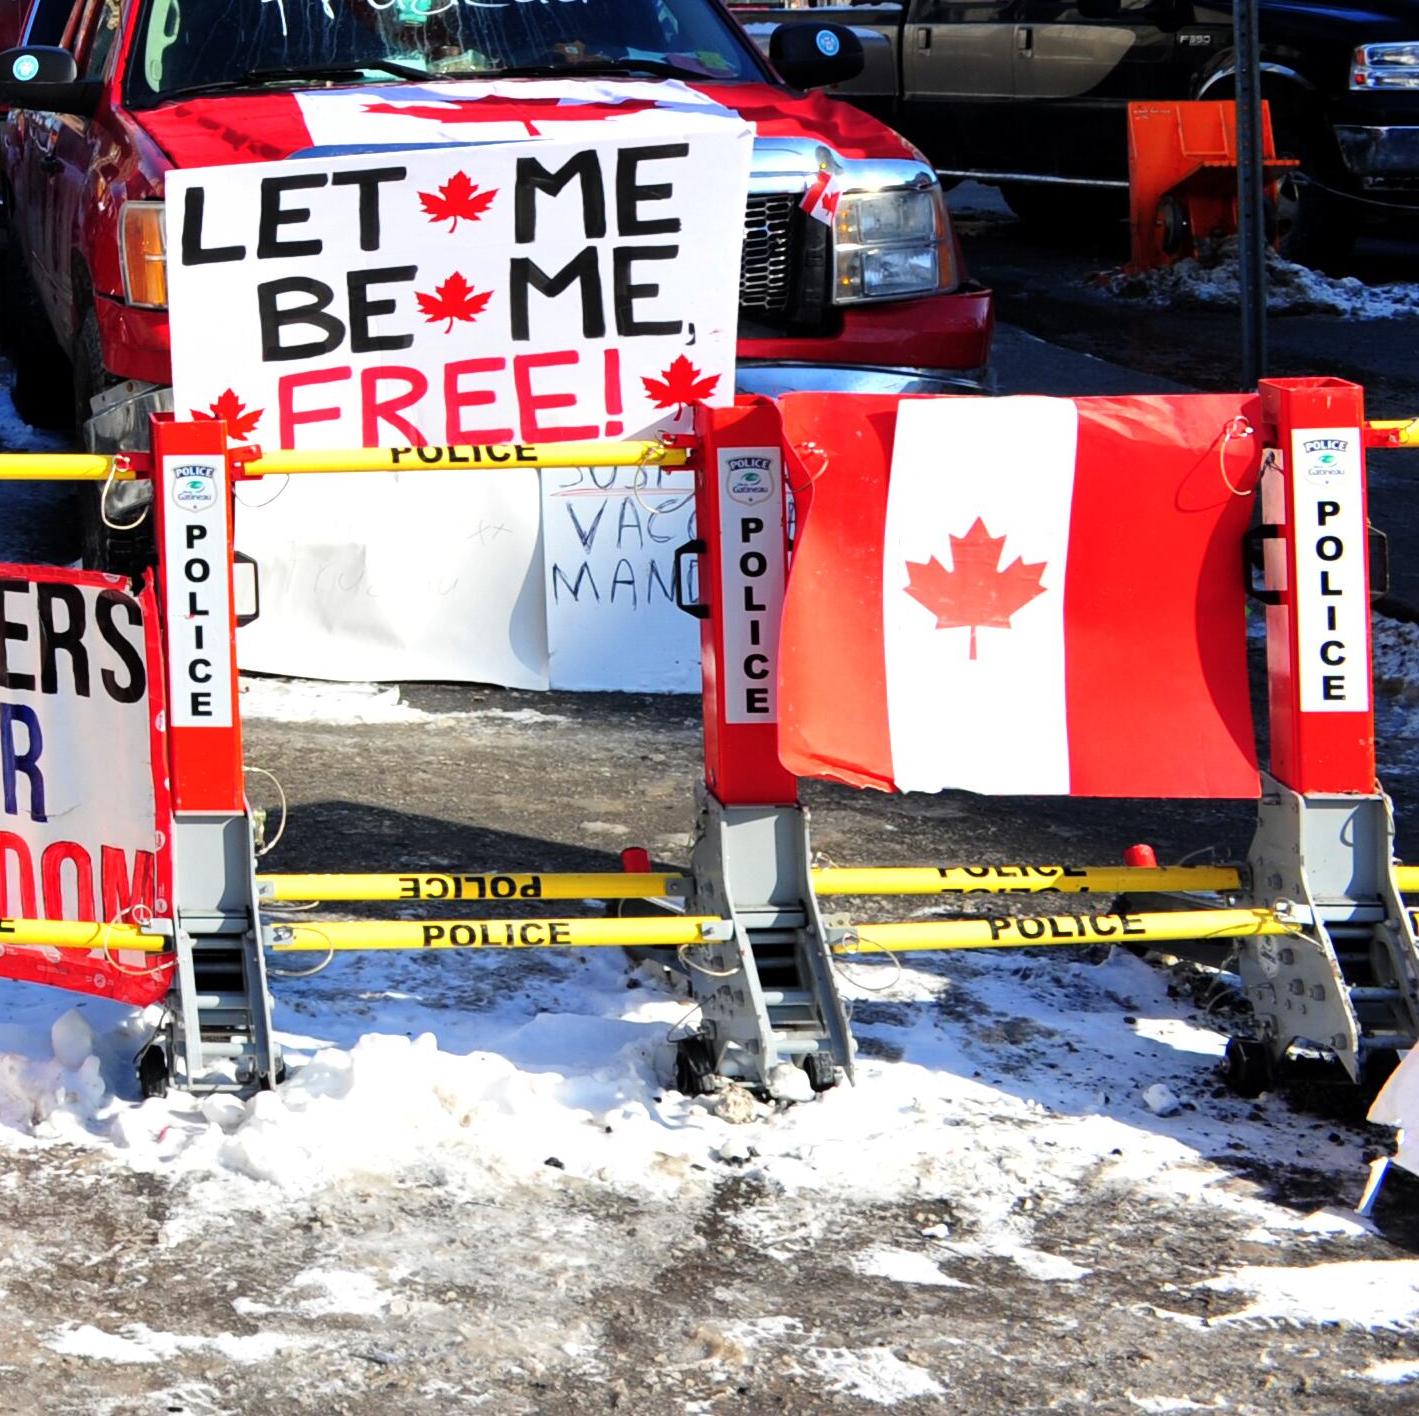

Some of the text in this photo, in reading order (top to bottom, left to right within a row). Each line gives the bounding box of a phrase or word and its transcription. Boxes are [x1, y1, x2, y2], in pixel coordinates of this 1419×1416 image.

[181, 142, 690, 266] LET ME
[257, 244, 698, 362] BE ME,
[277, 348, 623, 450] FREE!
[391, 445, 538, 464] POLICE
[1305, 440, 1347, 452] POLICE
[175, 465, 213, 478] POLICE
[730, 458, 769, 470] POLICE
[1315, 500, 1348, 702] POLICE
[184, 524, 214, 717] POLICE
[738, 517, 770, 715] POLICE
[399, 876, 542, 899] POLICE
[422, 922, 572, 946] POLICE
[988, 914, 1146, 940] POLICE
